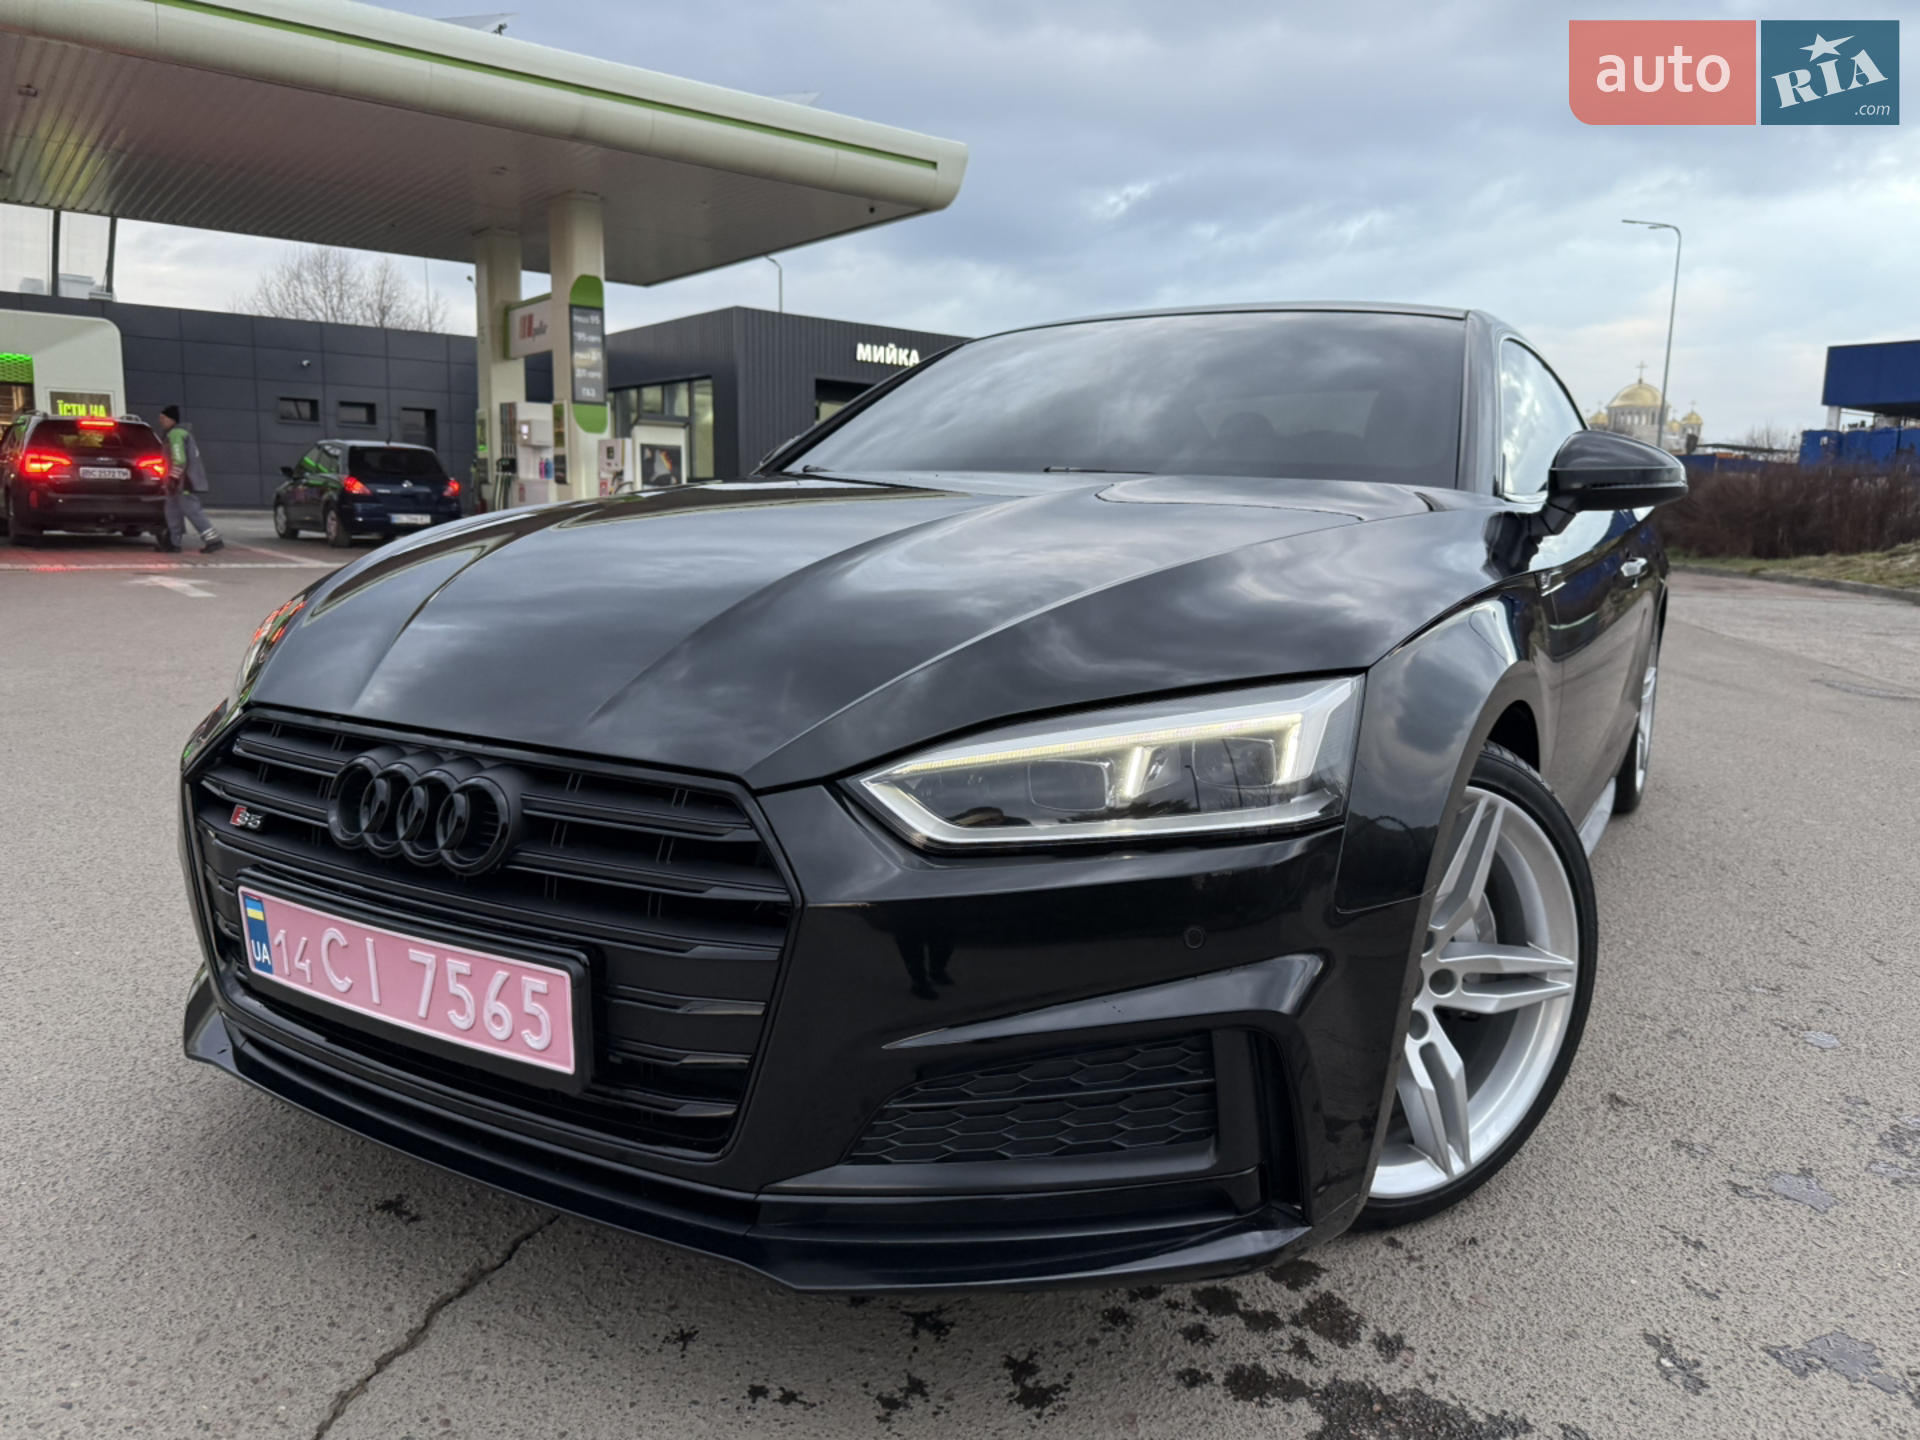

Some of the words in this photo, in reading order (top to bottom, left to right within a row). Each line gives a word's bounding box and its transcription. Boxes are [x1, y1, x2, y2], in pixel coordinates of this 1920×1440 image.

[856, 342, 920, 367] МИЙКА
[251, 938, 271, 966] UA
[408, 948, 552, 1051] 7565
